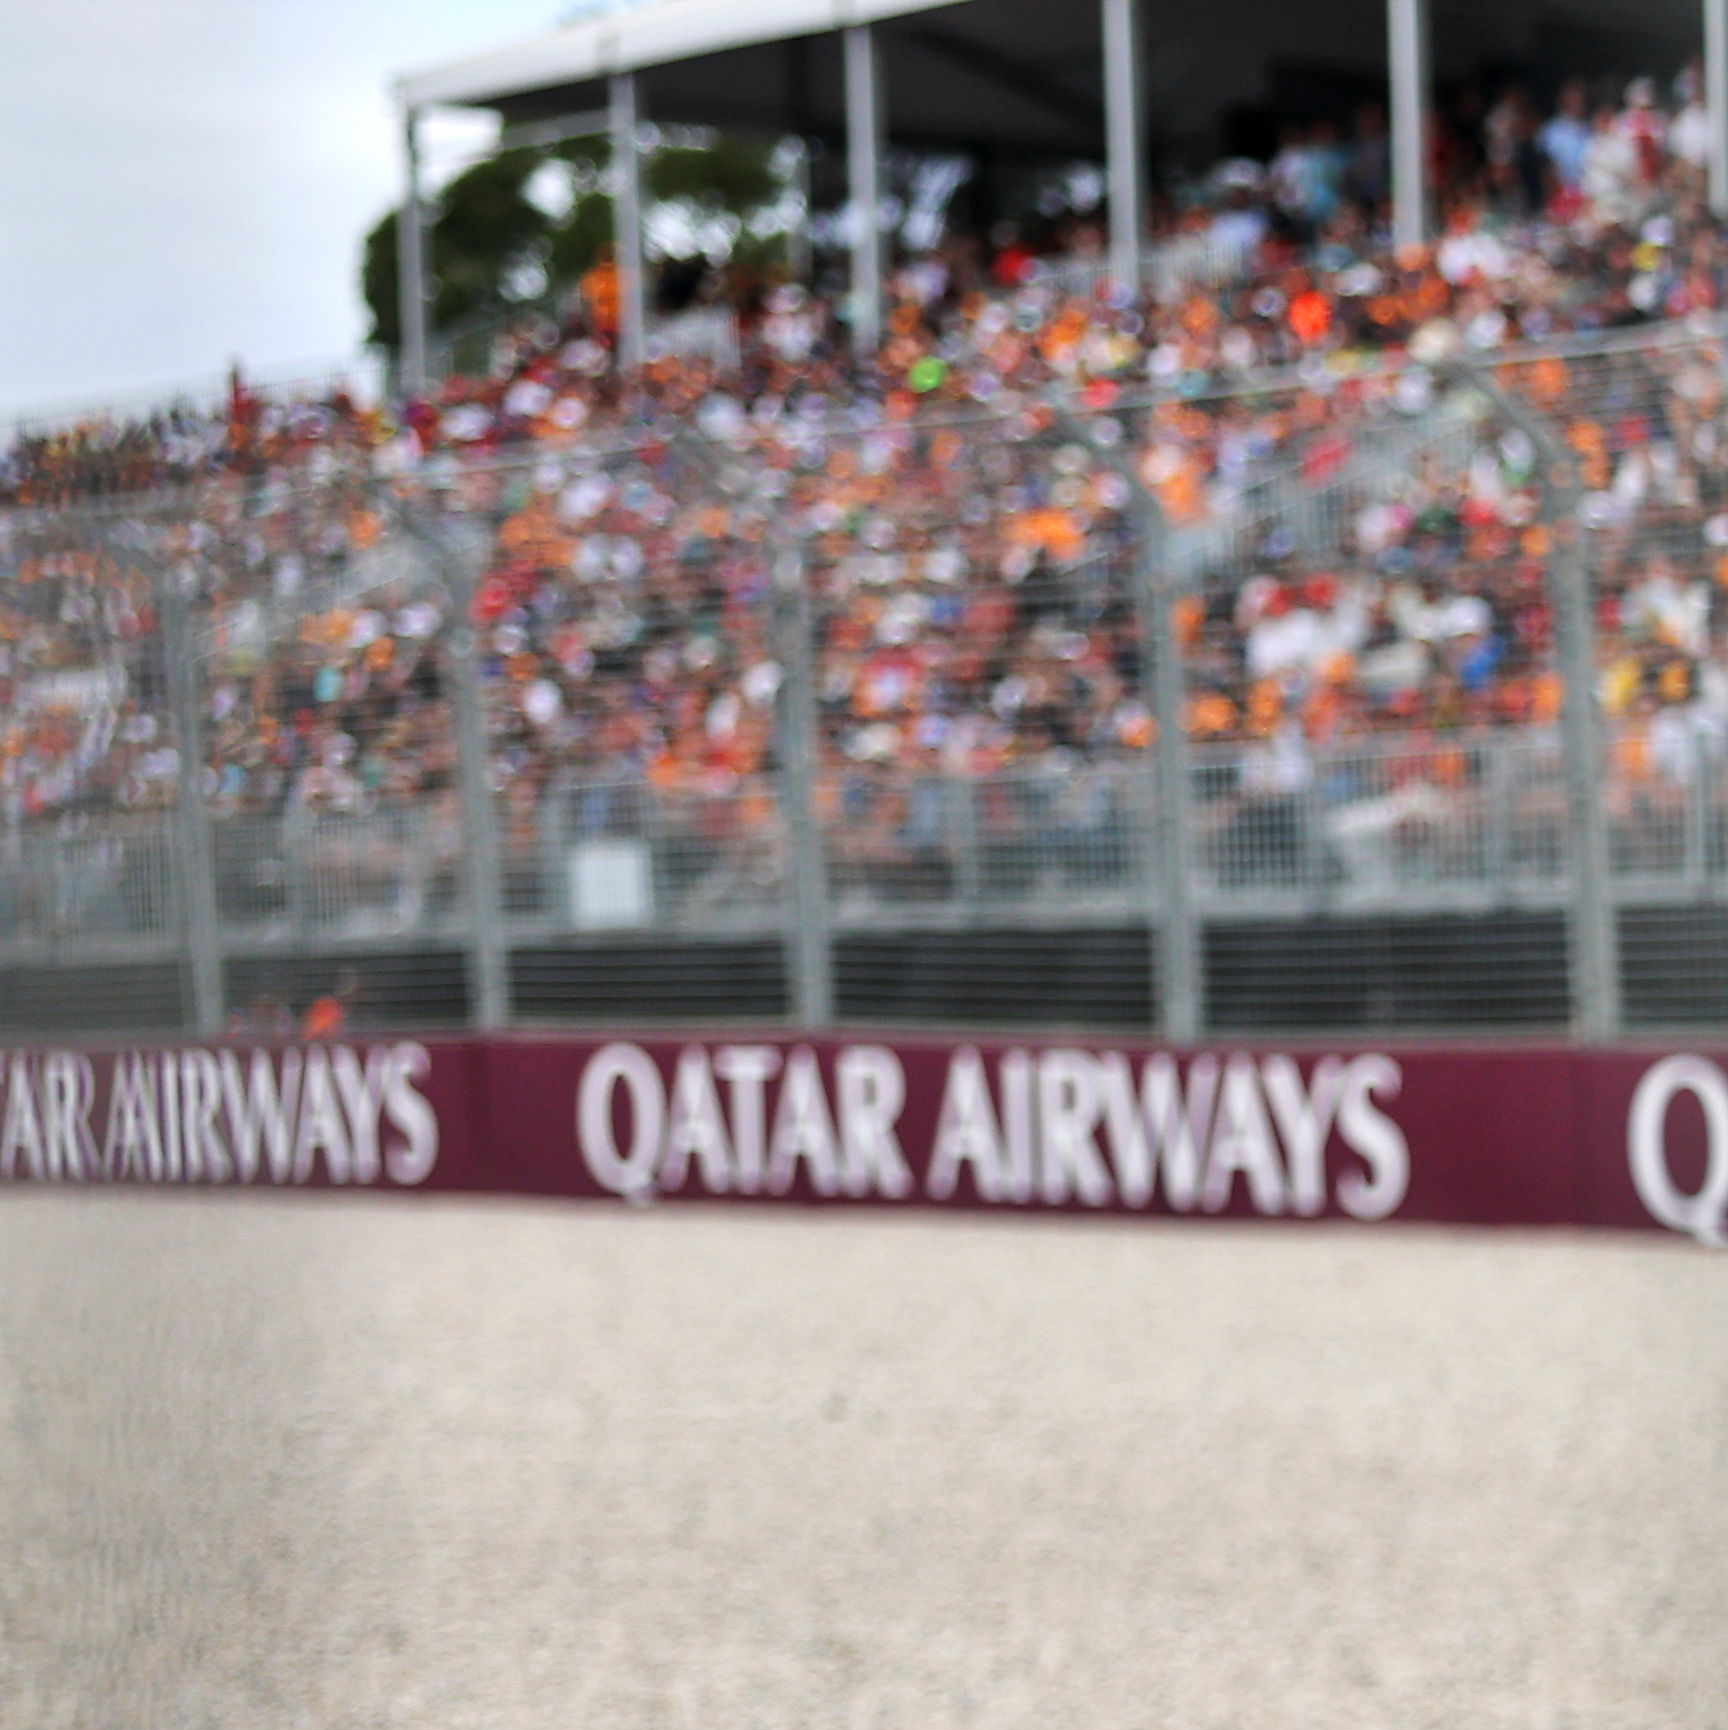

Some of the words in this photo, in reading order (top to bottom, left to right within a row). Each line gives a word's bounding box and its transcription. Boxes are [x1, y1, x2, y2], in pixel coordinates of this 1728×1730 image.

[0, 1044, 101, 1185] AR
[103, 1040, 439, 1186] AIRWAYS
[577, 1041, 913, 1207] QATAR
[928, 1043, 1410, 1220] AIRWAYS
